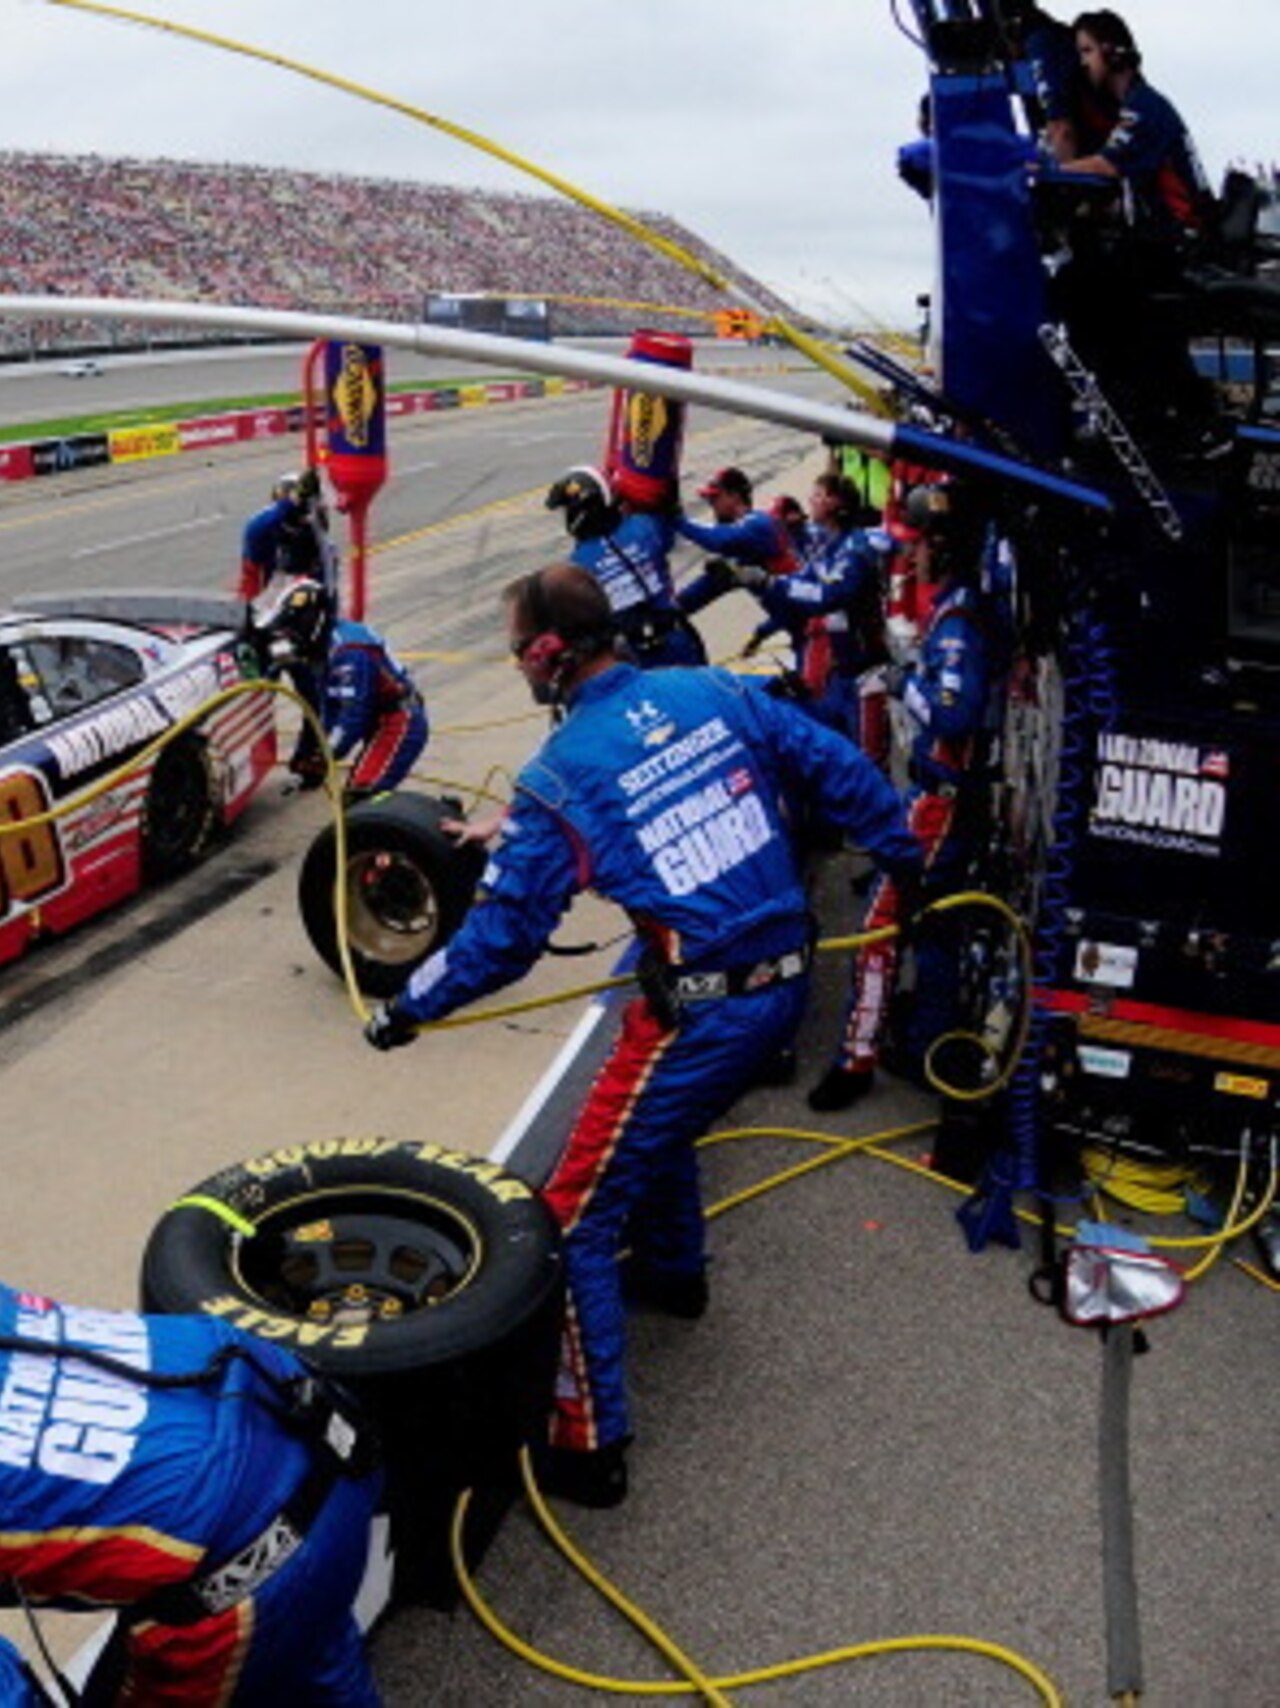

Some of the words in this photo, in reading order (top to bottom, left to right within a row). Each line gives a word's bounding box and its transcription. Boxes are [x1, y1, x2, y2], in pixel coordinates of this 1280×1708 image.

[637, 783, 734, 855] NATIONAL
[1095, 765, 1227, 836] GUARD
[651, 793, 772, 897] GUARD
[202, 1297, 370, 1347] EAGLE
